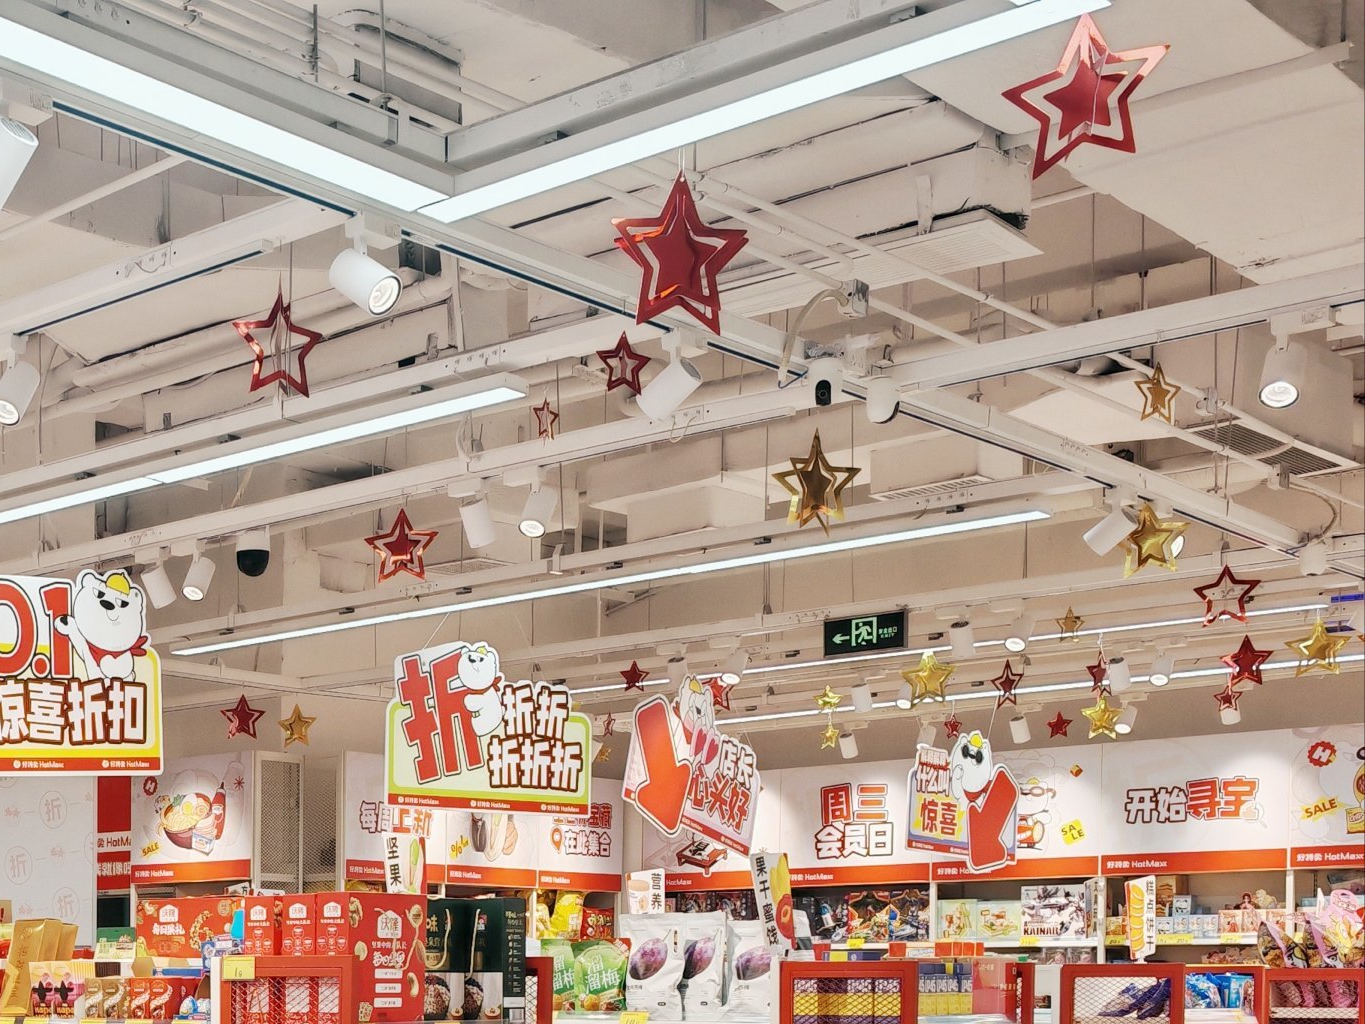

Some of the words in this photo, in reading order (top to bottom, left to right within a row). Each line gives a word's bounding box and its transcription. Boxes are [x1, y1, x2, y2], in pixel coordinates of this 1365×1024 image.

[399, 647, 484, 785] 折
[502, 682, 569, 739] 折折
[488, 736, 583, 792] 折折折
[689, 764, 751, 834] 心头好
[820, 783, 889, 826] 周三
[920, 798, 958, 837] 惊喜
[1124, 776, 1259, 824] 开始寻宝
[1304, 798, 1338, 819] SALE
[142, 842, 160, 857] SALE
[386, 837, 402, 887] 坚果
[564, 829, 612, 857] 在此集合
[814, 821, 894, 860] 会员日
[651, 873, 662, 910] 营养
